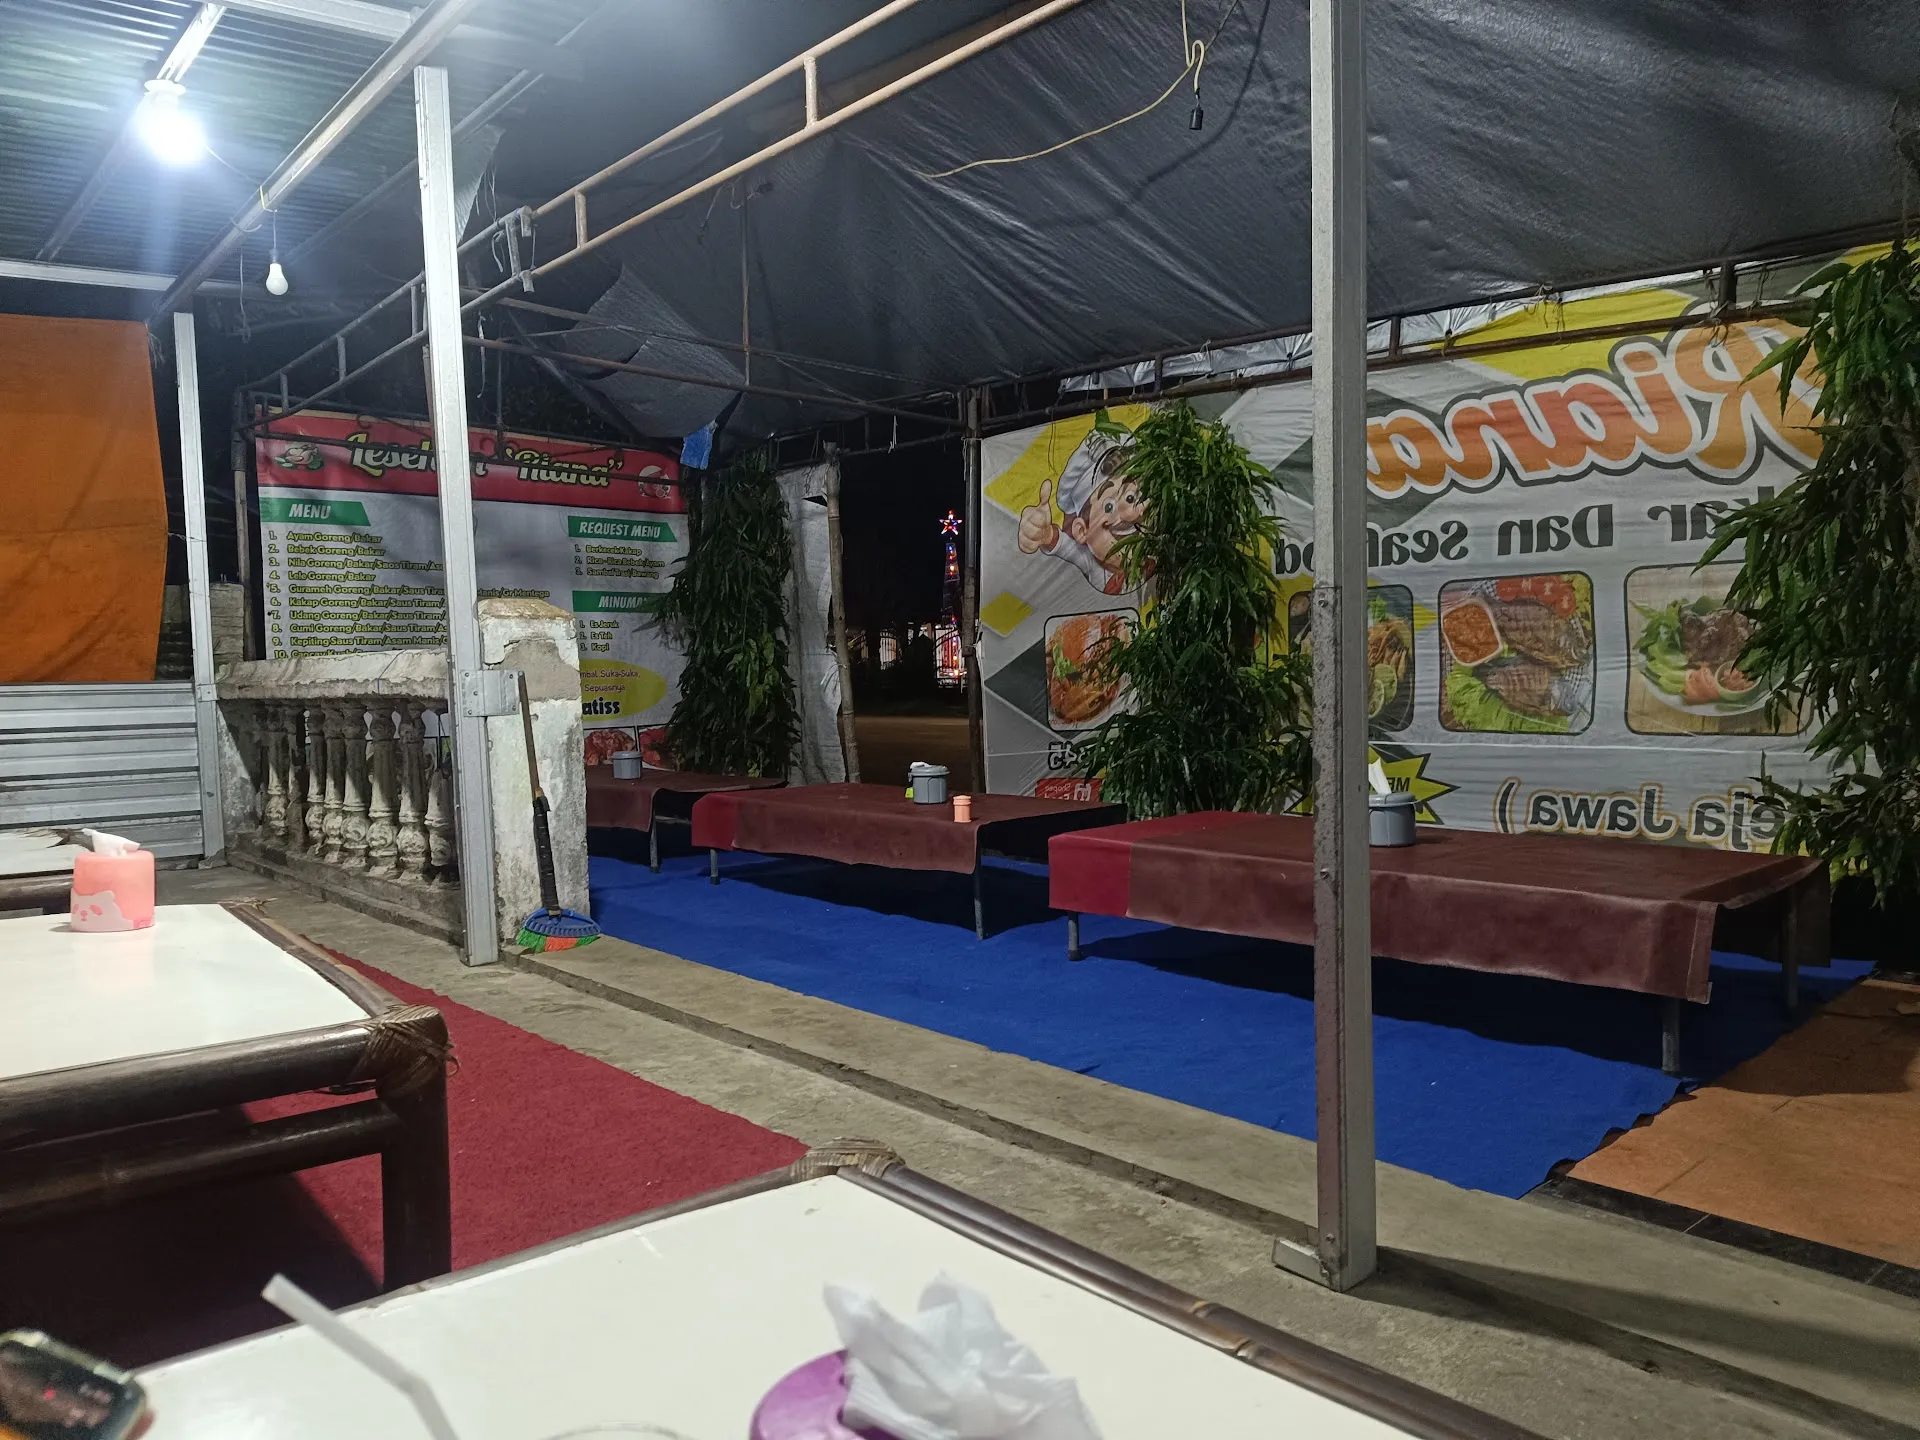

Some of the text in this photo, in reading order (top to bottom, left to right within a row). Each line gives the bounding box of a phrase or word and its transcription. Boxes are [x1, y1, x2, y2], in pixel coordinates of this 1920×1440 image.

[289, 504, 331, 519] MENU
[580, 522, 660, 538] REQUEST MENU
[269, 531, 383, 544] 1. Ayam Goreng/Bakar
[268, 544, 386, 557] 2. Bebek Goreng/Bakar
[269, 558, 280, 567] 3.
[287, 558, 307, 567] Nila
[269, 571, 377, 582] 4. Lele Goreng/Bakar
[289, 584, 332, 594] Gurameh
[271, 597, 281, 607] 6.
[289, 597, 319, 608] Kakap
[271, 610, 281, 620] 7.
[290, 611, 320, 621] Udang
[271, 623, 282, 633] 8.
[290, 624, 315, 633] Cumi
[599, 620, 619, 629] Jeruk
[599, 632, 613, 640] Teh
[272, 637, 282, 646] 9.
[290, 637, 330, 648] Kepiting
[330, 637, 354, 646] Saus
[591, 643, 610, 652] Kopi
[274, 649, 288, 659] 10.
[584, 683, 625, 693] Sepuasnya
[582, 696, 620, 715] atiss
